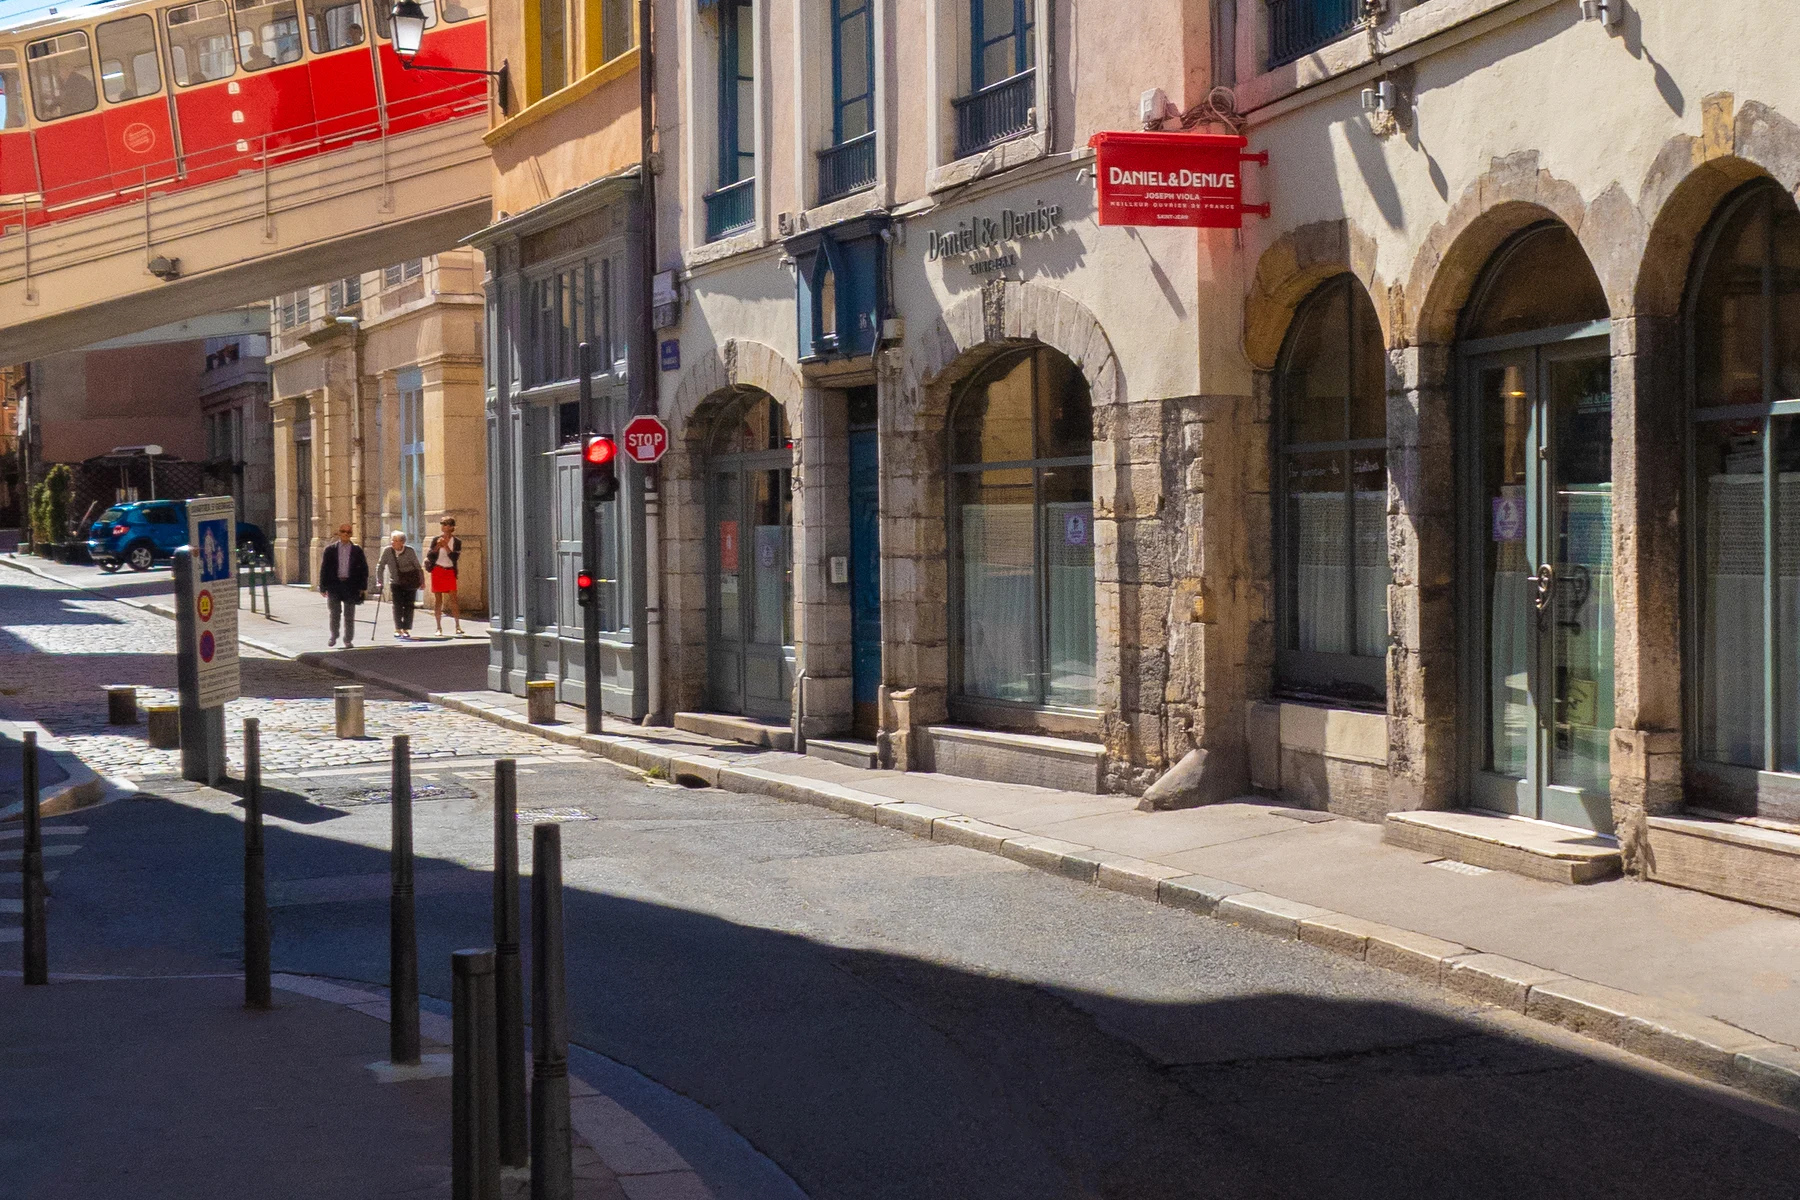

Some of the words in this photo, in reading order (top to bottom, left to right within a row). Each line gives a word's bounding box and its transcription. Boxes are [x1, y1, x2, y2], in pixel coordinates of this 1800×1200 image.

[1144, 192, 1175, 200] JOSEPH
[1176, 193, 1201, 201] VIOLA
[1190, 202, 1201, 210] DE
[927, 215, 979, 262] Daniel
[980, 215, 999, 247] &
[1001, 198, 1064, 242] Denise
[628, 432, 663, 447] STOP
